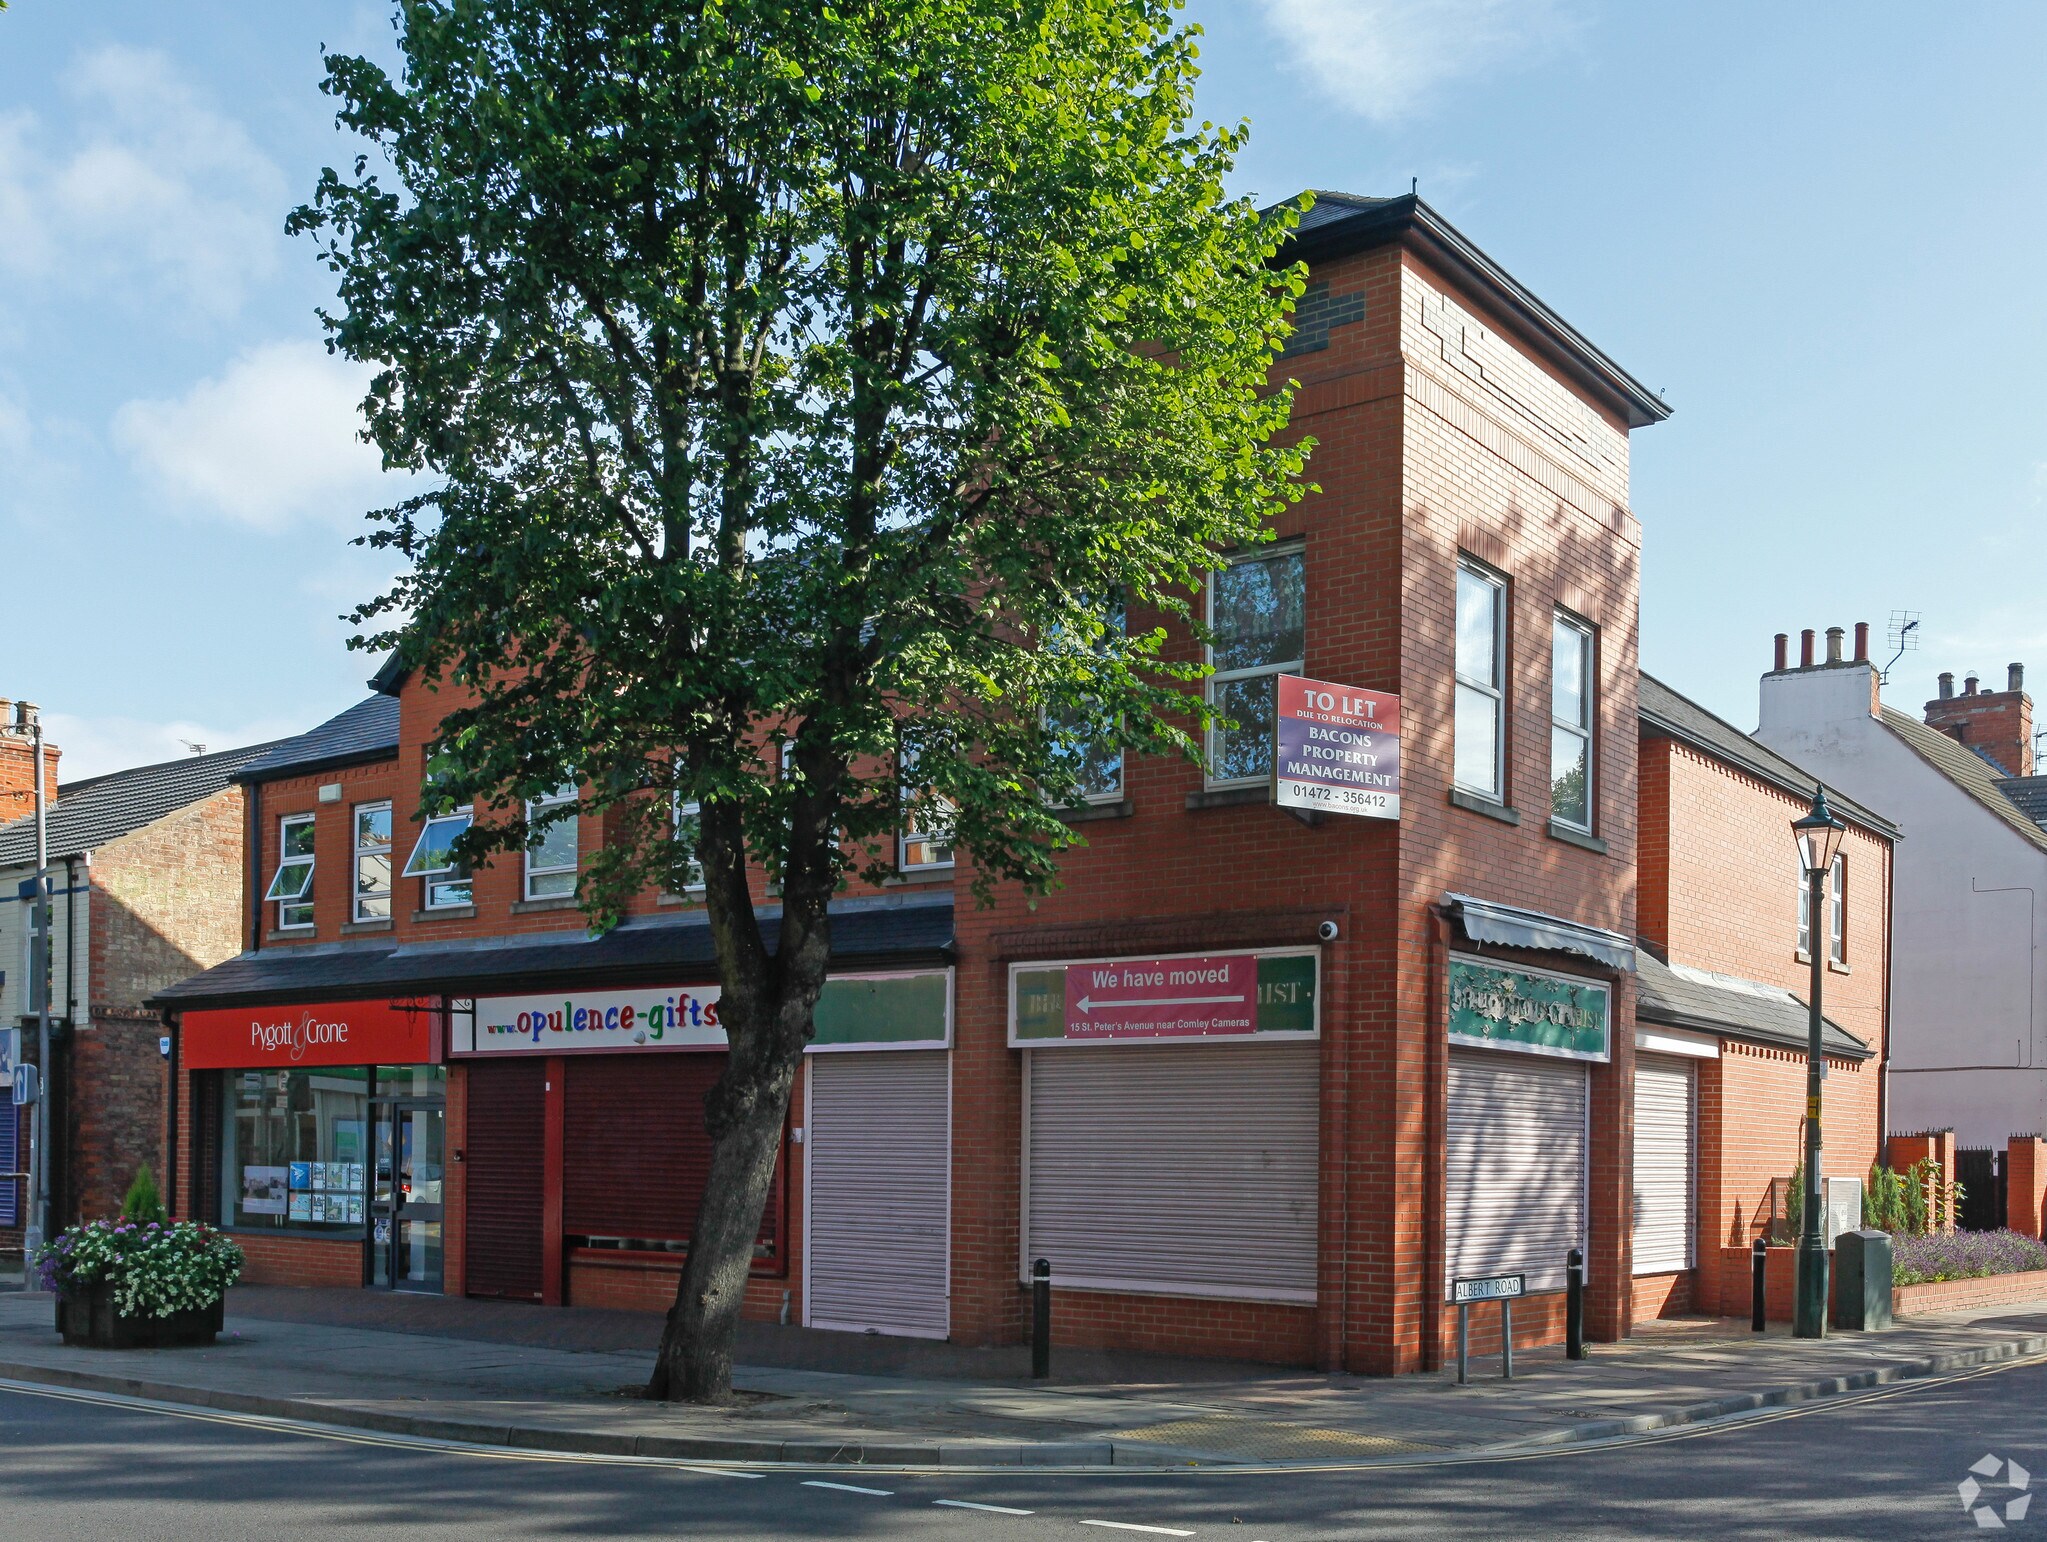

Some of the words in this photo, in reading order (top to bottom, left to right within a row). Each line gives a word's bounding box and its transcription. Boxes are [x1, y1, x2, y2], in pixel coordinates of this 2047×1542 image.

[1304, 689, 1335, 711] TO
[1342, 696, 1377, 719] LET
[1296, 709, 1315, 719] DUE
[1317, 712, 1329, 721] TO
[1331, 714, 1383, 730] RELOCATION
[1309, 726, 1372, 747] BACONS
[1302, 744, 1379, 767] PROPERTY
[1287, 761, 1392, 787] MANAGEMENT
[1293, 784, 1331, 801] 01472
[1343, 791, 1386, 808] 356412
[1092, 970, 1118, 989] We
[1123, 968, 1164, 987] have
[1169, 964, 1230, 985] moved
[251, 1020, 292, 1052] Pygott
[306, 1018, 348, 1045] Crone
[1071, 1022, 1080, 1032] 15
[1081, 1022, 1092, 1031] St.
[1094, 1020, 1122, 1031] Peter's
[1123, 1020, 1154, 1031] Avenue
[1156, 1021, 1176, 1030] near
[1177, 1018, 1209, 1031] Comley
[1211, 1017, 1250, 1029] Cameras
[1456, 1281, 1490, 1298] ALBERT
[1495, 1279, 1519, 1294] ROAD
